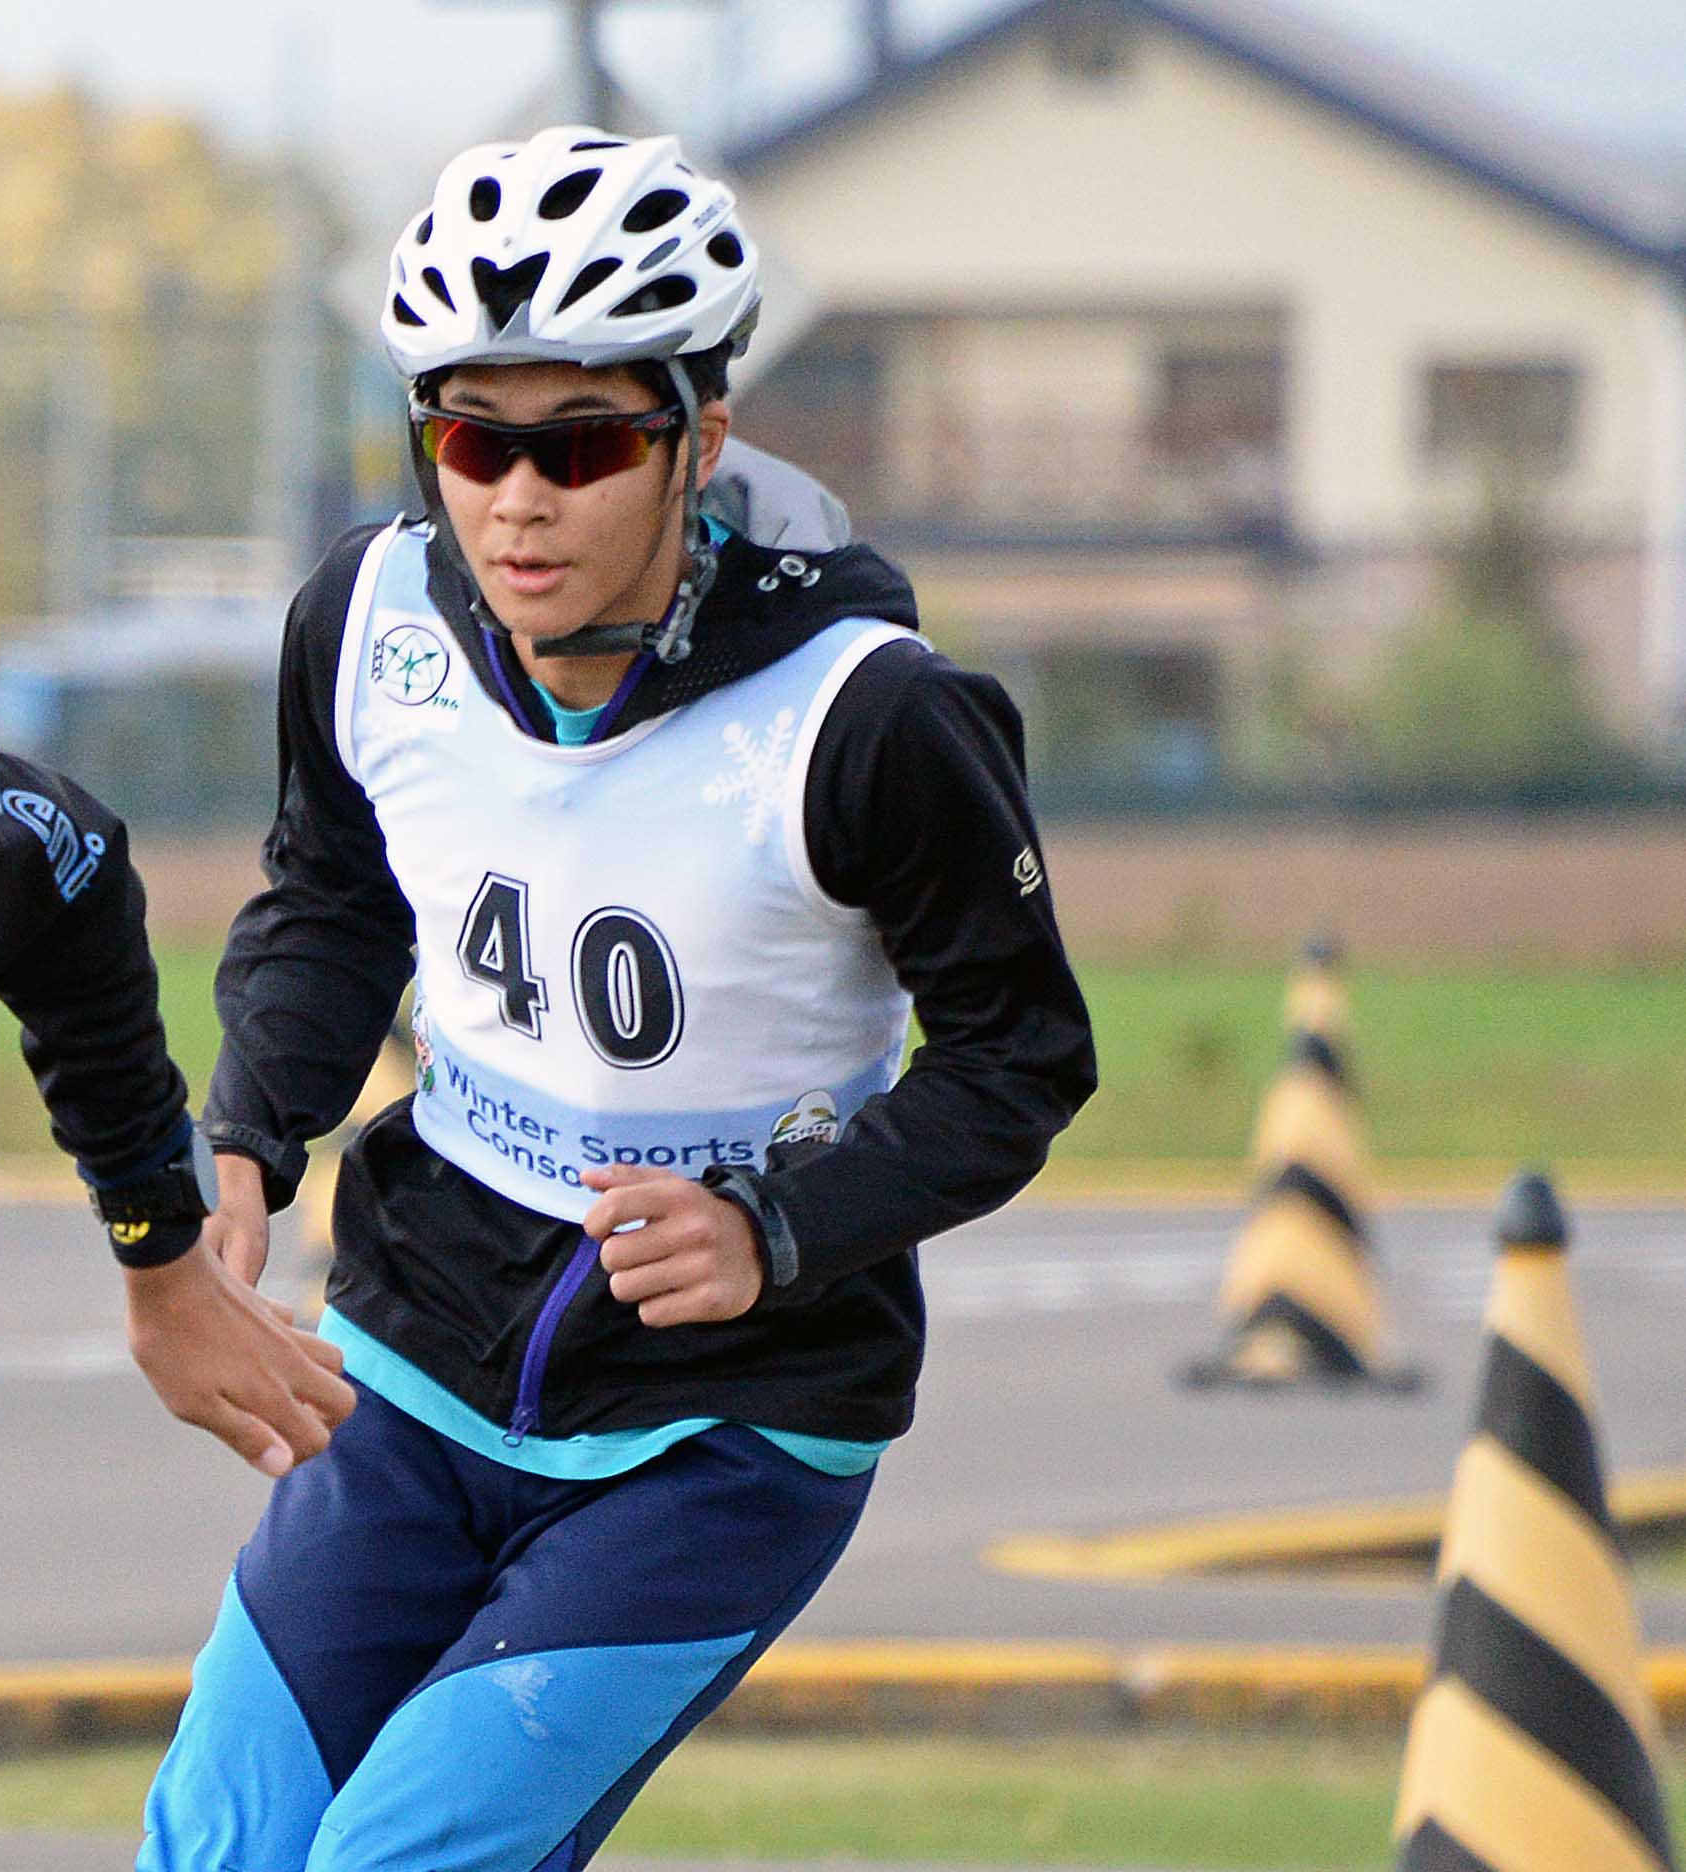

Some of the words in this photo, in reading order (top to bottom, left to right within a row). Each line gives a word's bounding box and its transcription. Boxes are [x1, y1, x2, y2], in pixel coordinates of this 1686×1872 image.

[458, 872, 685, 1071] 40
[444, 1056, 560, 1146] Winter
[580, 1134, 756, 1168] Sports
[465, 1108, 585, 1189] Conso
